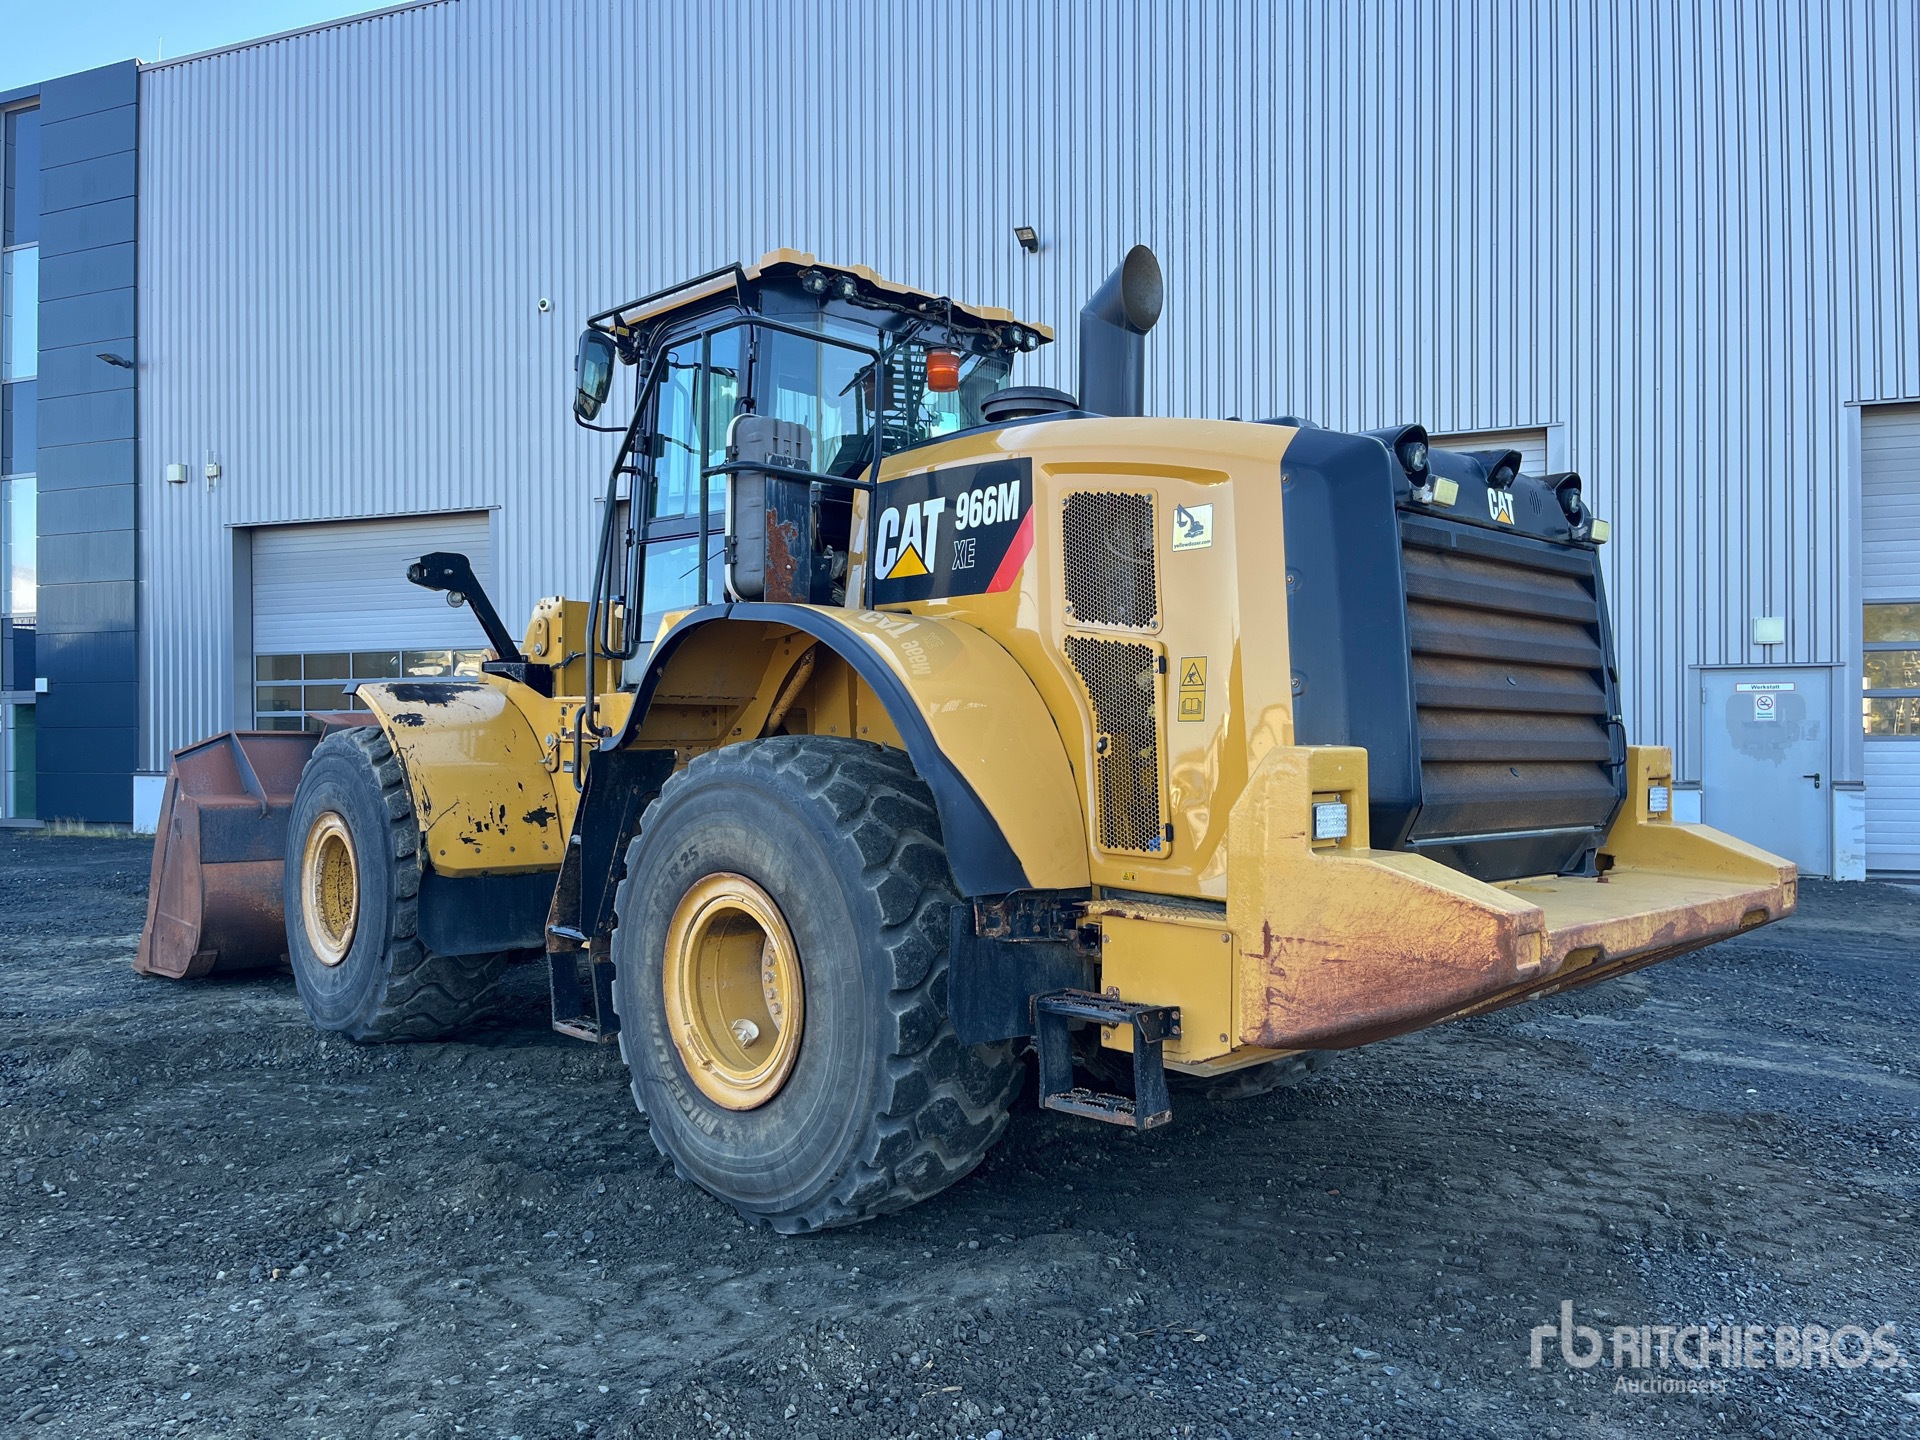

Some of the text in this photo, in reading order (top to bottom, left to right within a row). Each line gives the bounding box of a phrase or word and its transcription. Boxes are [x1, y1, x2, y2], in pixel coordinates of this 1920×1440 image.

[955, 480, 1020, 530] 966M
[1487, 487, 1515, 525] CAT
[875, 497, 945, 580] CAT
[952, 538, 976, 570] XE
